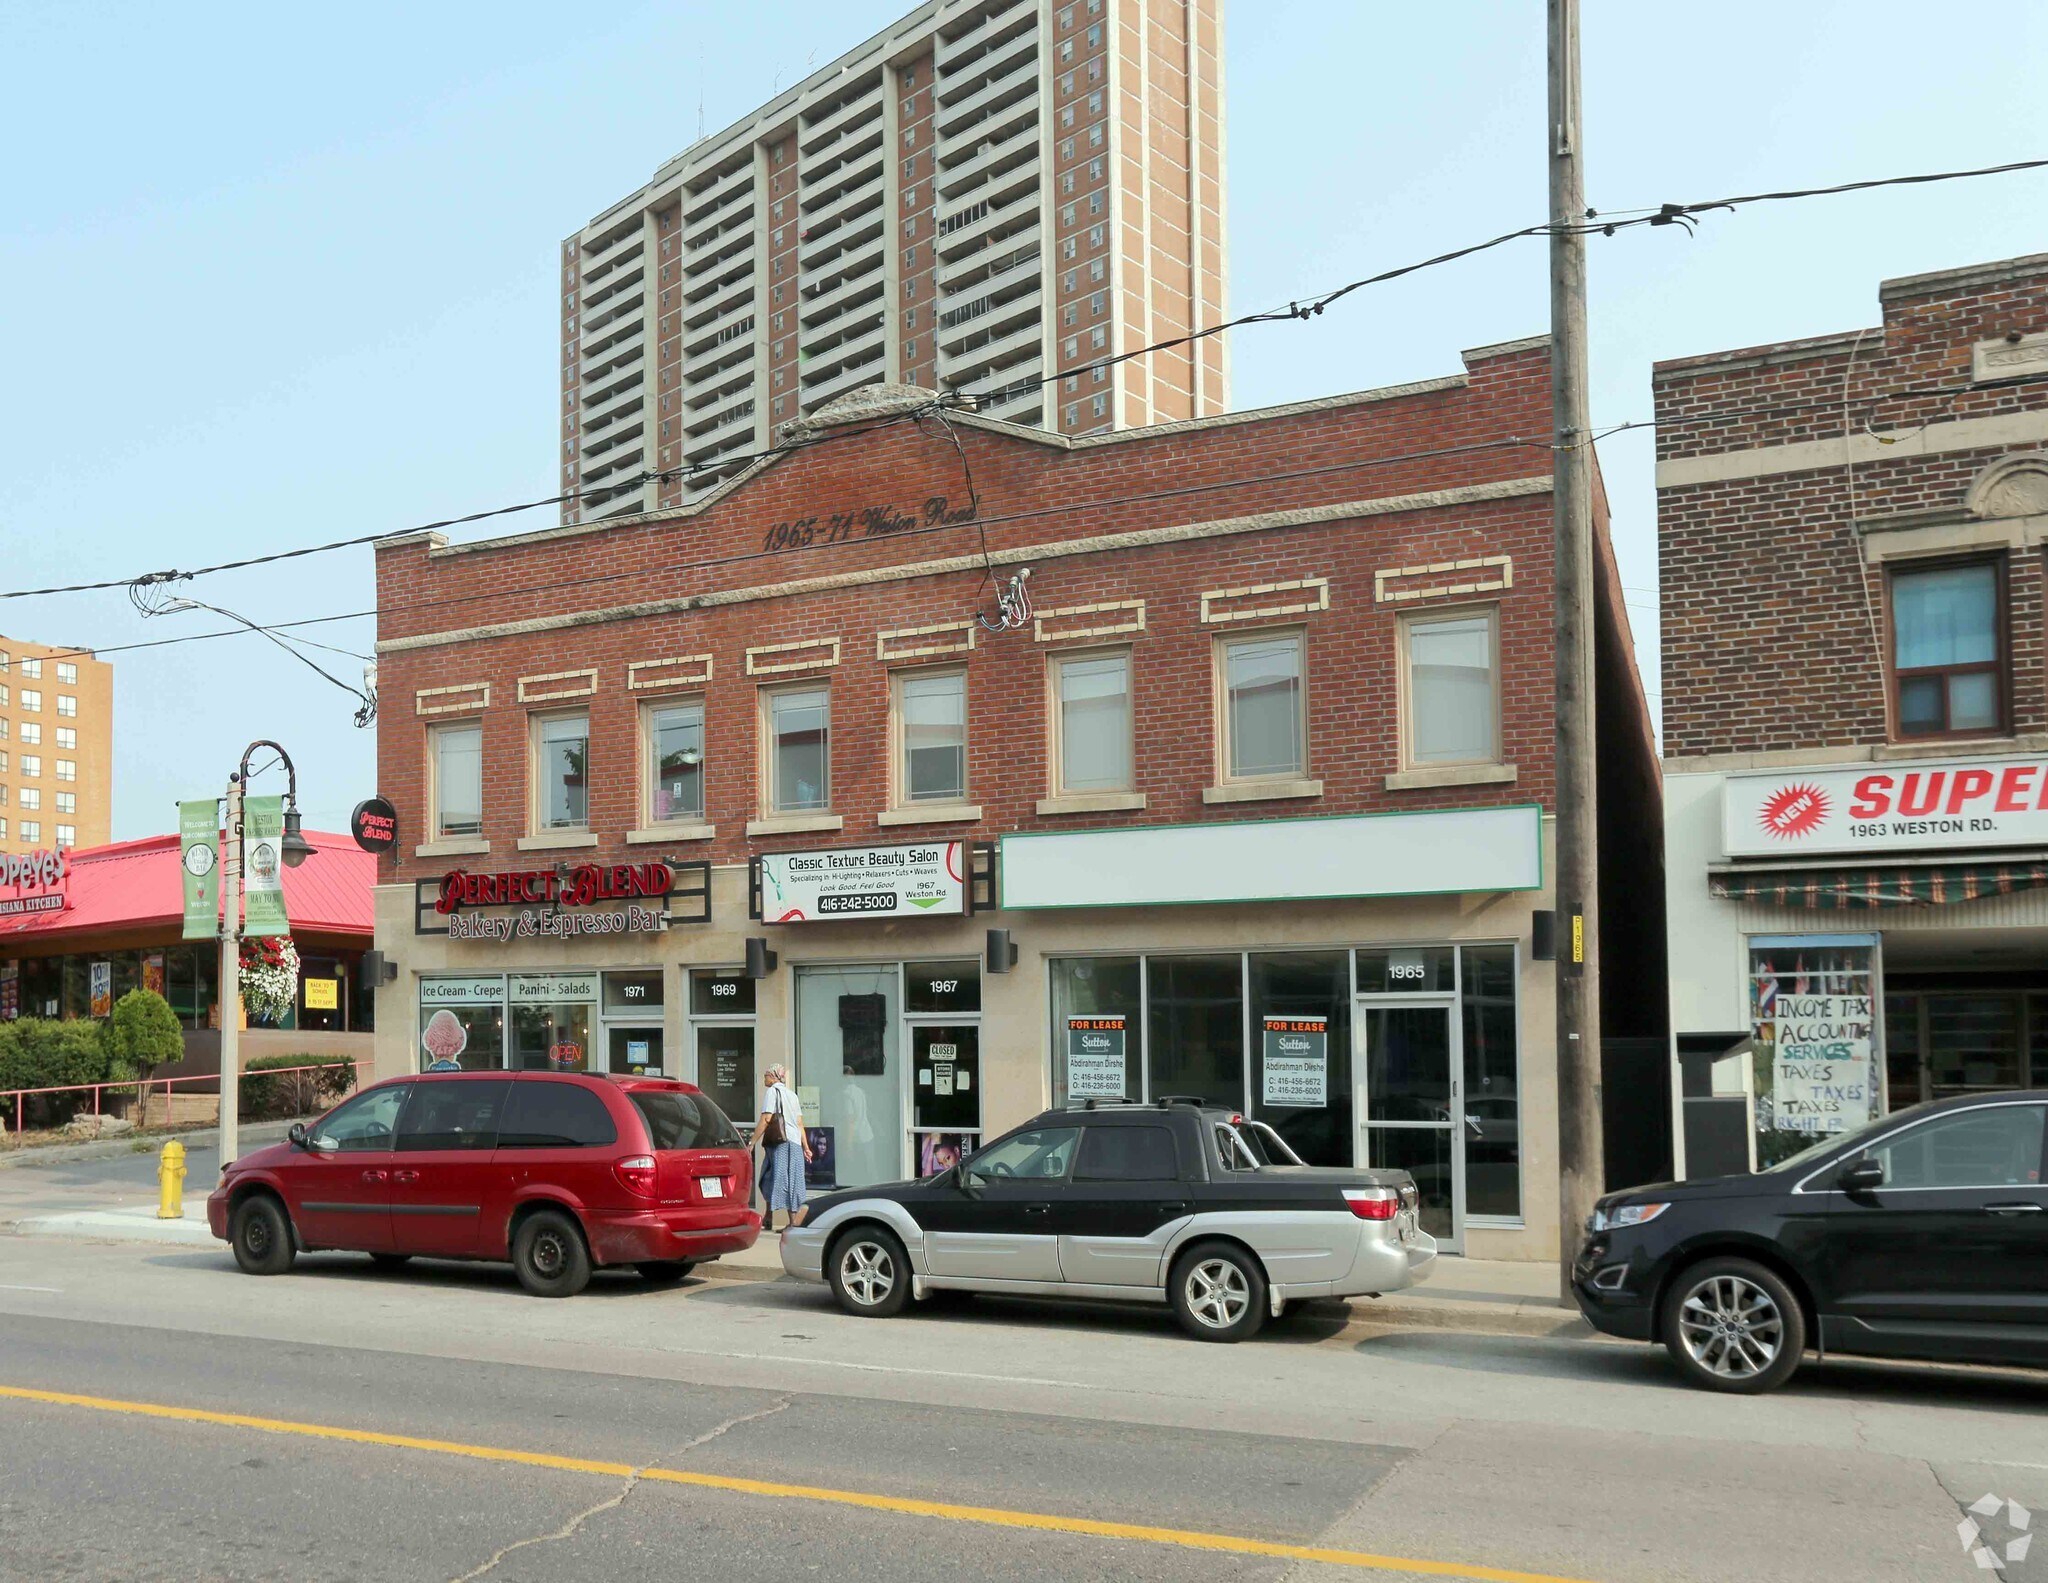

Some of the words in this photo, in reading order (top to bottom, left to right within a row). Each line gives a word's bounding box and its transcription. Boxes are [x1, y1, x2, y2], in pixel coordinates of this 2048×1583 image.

[763, 510, 855, 551] 1965-71
[858, 504, 917, 537] Weston
[1849, 766, 2048, 819] SUPE
[1773, 793, 1813, 829] NEW
[360, 811, 395, 828] PERFECT
[363, 825, 392, 840] BLEND
[1849, 823, 1887, 837] 1963
[1892, 820, 1963, 836] WESTON
[1970, 818, 1998, 832] RD.
[789, 857, 823, 870] Classic
[827, 854, 864, 868] Texture
[869, 851, 904, 866] Beauty
[909, 849, 938, 862] Salon
[790, 875, 822, 883] Specializing
[866, 870, 891, 878] Relaxers
[435, 869, 559, 914] PERFECT
[560, 863, 675, 906] BLEND
[905, 890, 933, 898] Weston
[26, 895, 63, 911] KITCHEN
[821, 895, 894, 911] 416-242-5000
[449, 911, 511, 942] Bakery
[517, 910, 537, 936] &
[540, 908, 623, 939] Espresso
[628, 905, 665, 931] Bar
[1389, 965, 1425, 979] 1965
[423, 985, 436, 996] Ice
[437, 985, 466, 996] Cream
[519, 983, 549, 995] Panini
[558, 982, 591, 995] Salads
[624, 986, 645, 997] 1971
[711, 984, 736, 996] 1969
[930, 980, 957, 992] 1967
[1778, 998, 1832, 1018] INCOME
[1841, 998, 1869, 1016] TAX
[1071, 1021, 1089, 1029] FOR
[1093, 1021, 1123, 1029] LEASE
[1267, 1021, 1287, 1030] FOR
[1291, 1022, 1325, 1031] LEASE
[1081, 1035, 1111, 1048] Sutton
[1279, 1037, 1311, 1050] Sutton
[550, 1044, 582, 1062] OPEN
[932, 1045, 954, 1055] CLOSED
[1071, 1060, 1103, 1068] Abdirahman
[1105, 1060, 1123, 1068] Dirshe
[1266, 1062, 1302, 1071] Abdirahman
[1304, 1063, 1324, 1072] Dirshe
[1780, 1064, 1832, 1081] TAXES
[1811, 1084, 1864, 1101] TAXES
[1783, 1100, 1840, 1114] TAXES
